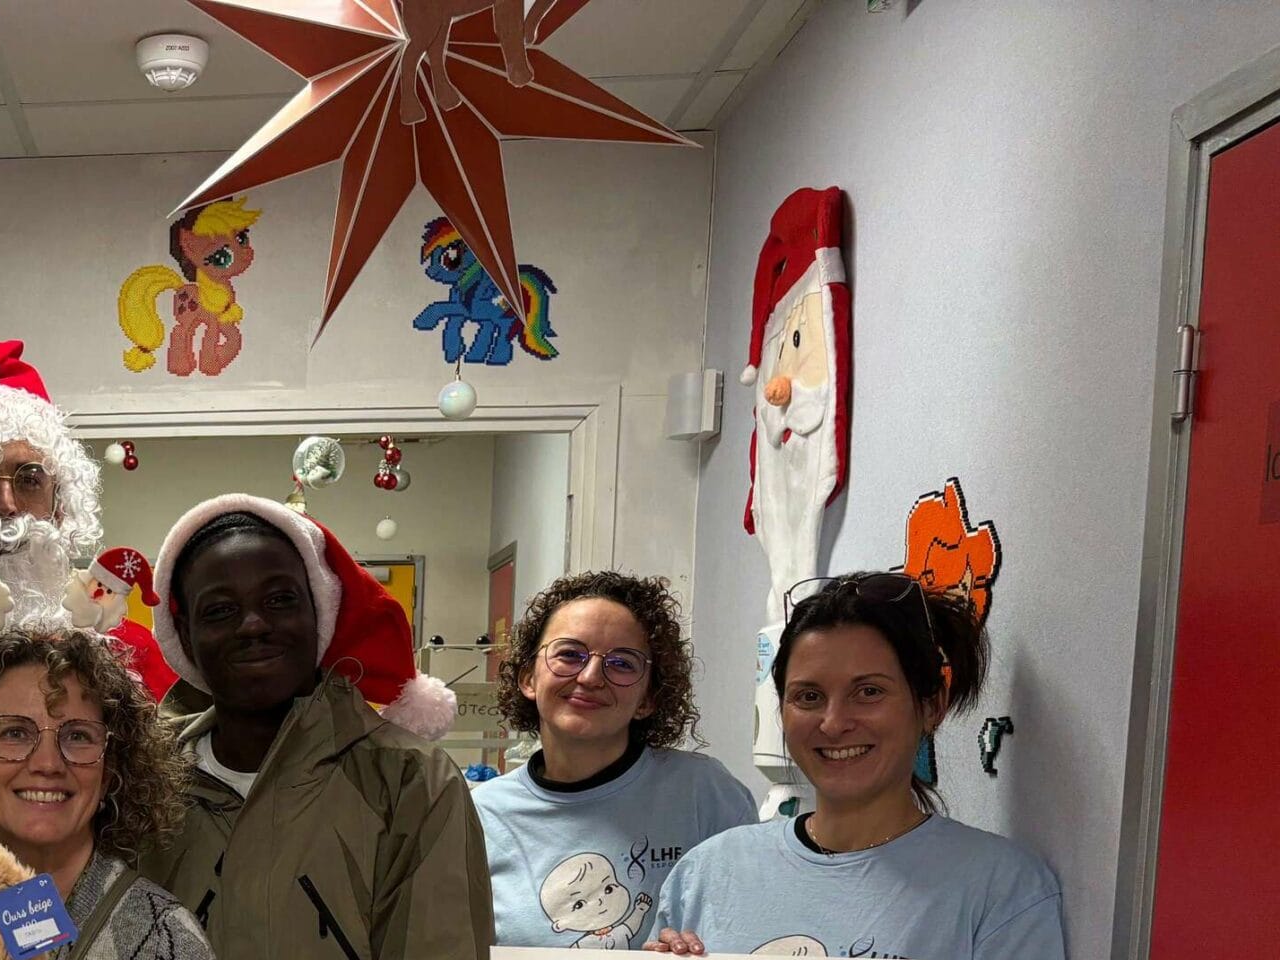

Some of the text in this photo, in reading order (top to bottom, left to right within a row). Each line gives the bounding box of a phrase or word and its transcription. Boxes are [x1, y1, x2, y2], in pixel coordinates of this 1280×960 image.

[650, 846, 682, 862] LHF
[2, 909, 28, 926] Ours
[27, 897, 54, 916] beige
